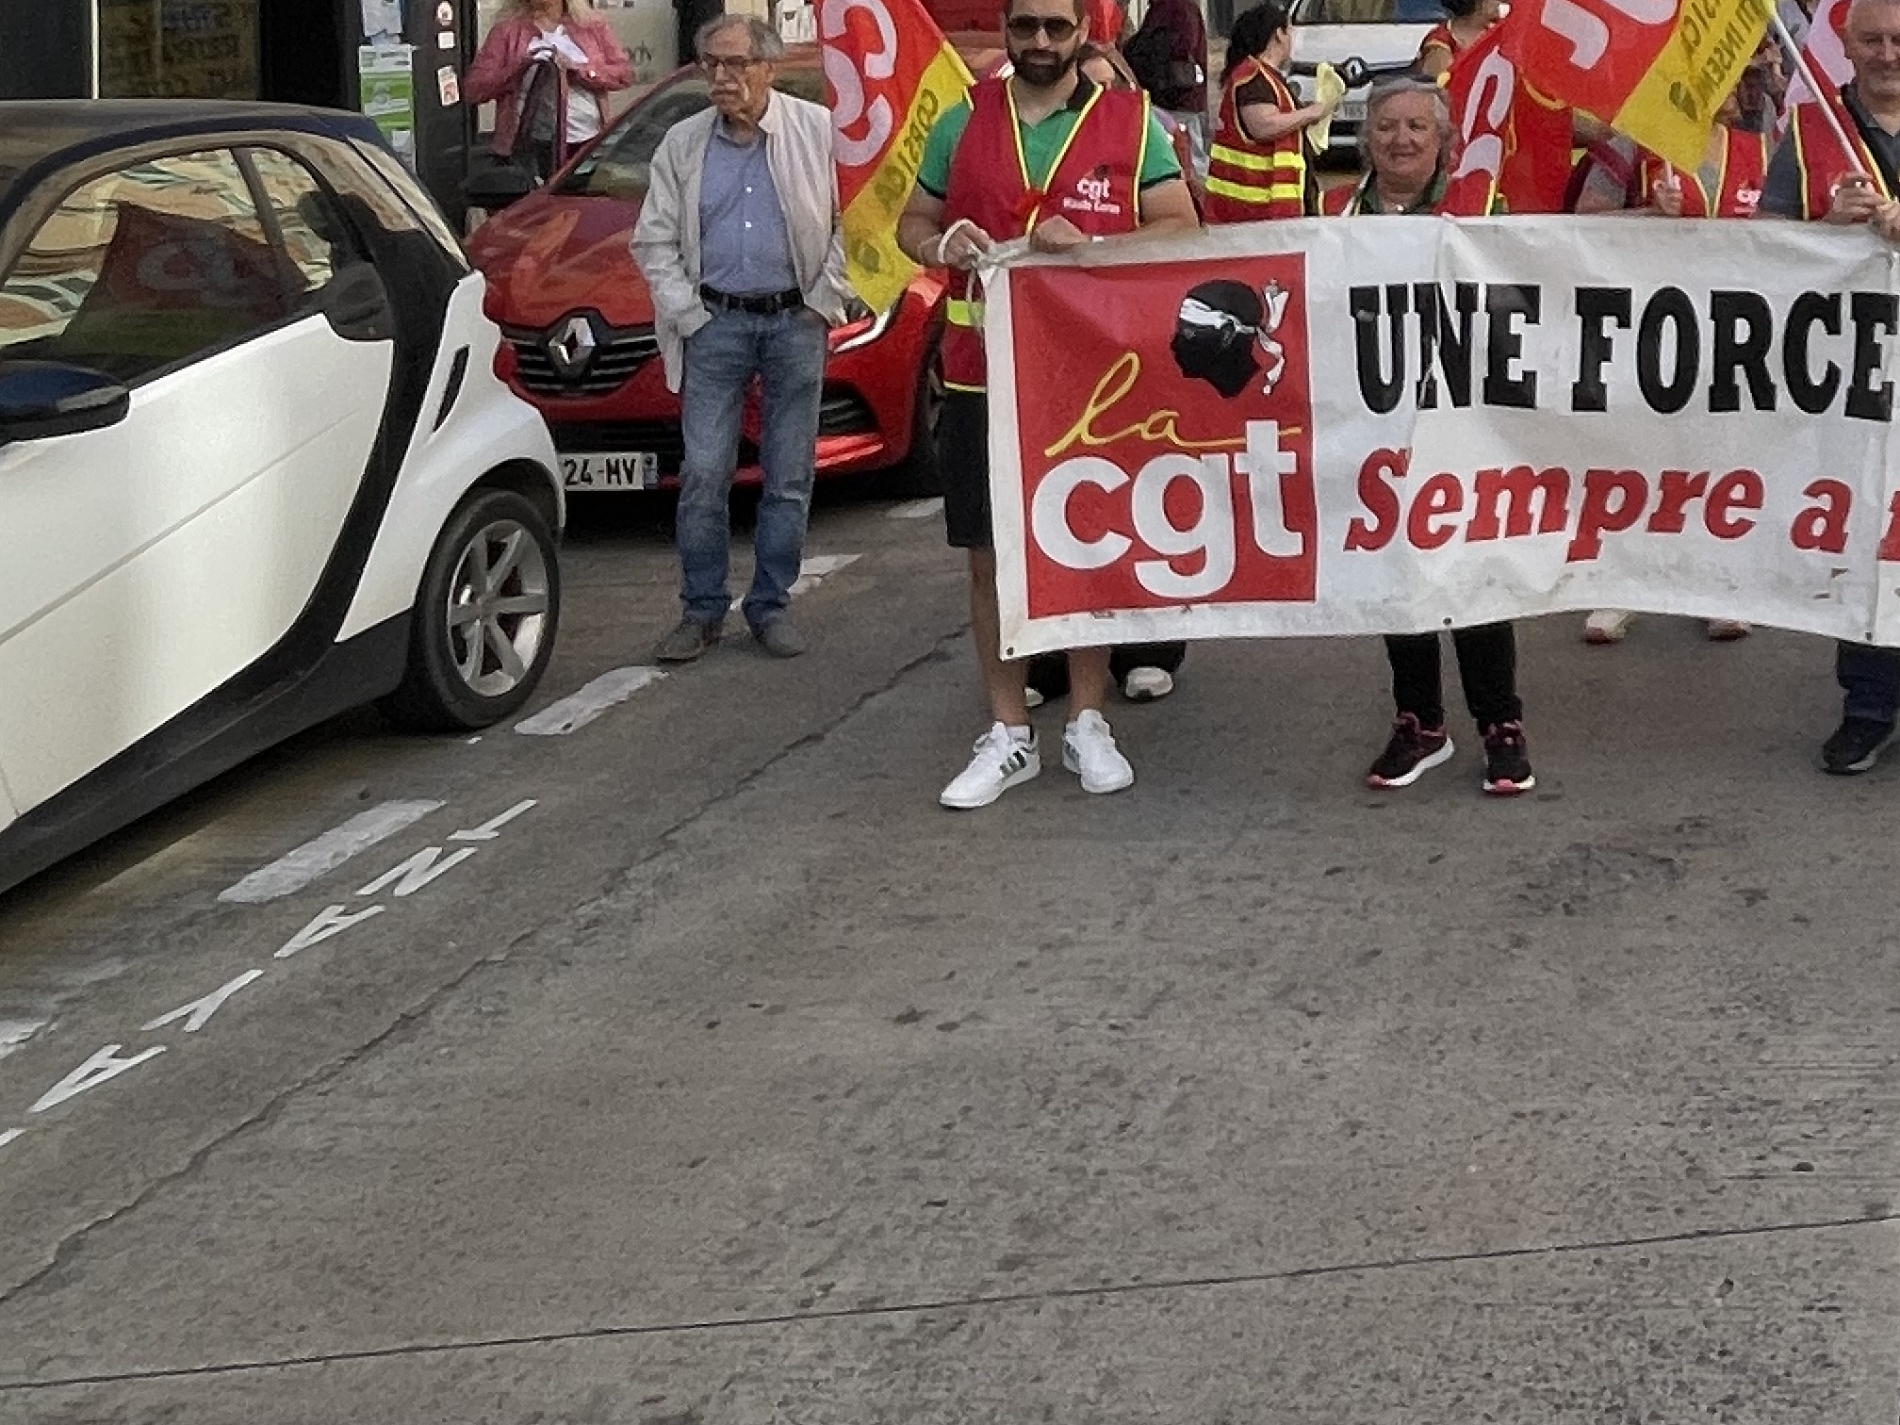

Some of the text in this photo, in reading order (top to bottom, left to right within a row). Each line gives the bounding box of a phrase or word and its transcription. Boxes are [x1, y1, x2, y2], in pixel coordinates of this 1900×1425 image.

[1076, 177, 1111, 200] cgt
[1045, 352, 1301, 457] la
[1349, 281, 1541, 414] UNE
[1571, 286, 1900, 422] FORCE
[562, 458, 637, 486] 24-HV
[1031, 420, 1306, 599] cgt
[1343, 446, 1765, 564] Sempre
[1790, 477, 1853, 554] a
[0, 799, 538, 1146] AYANT
